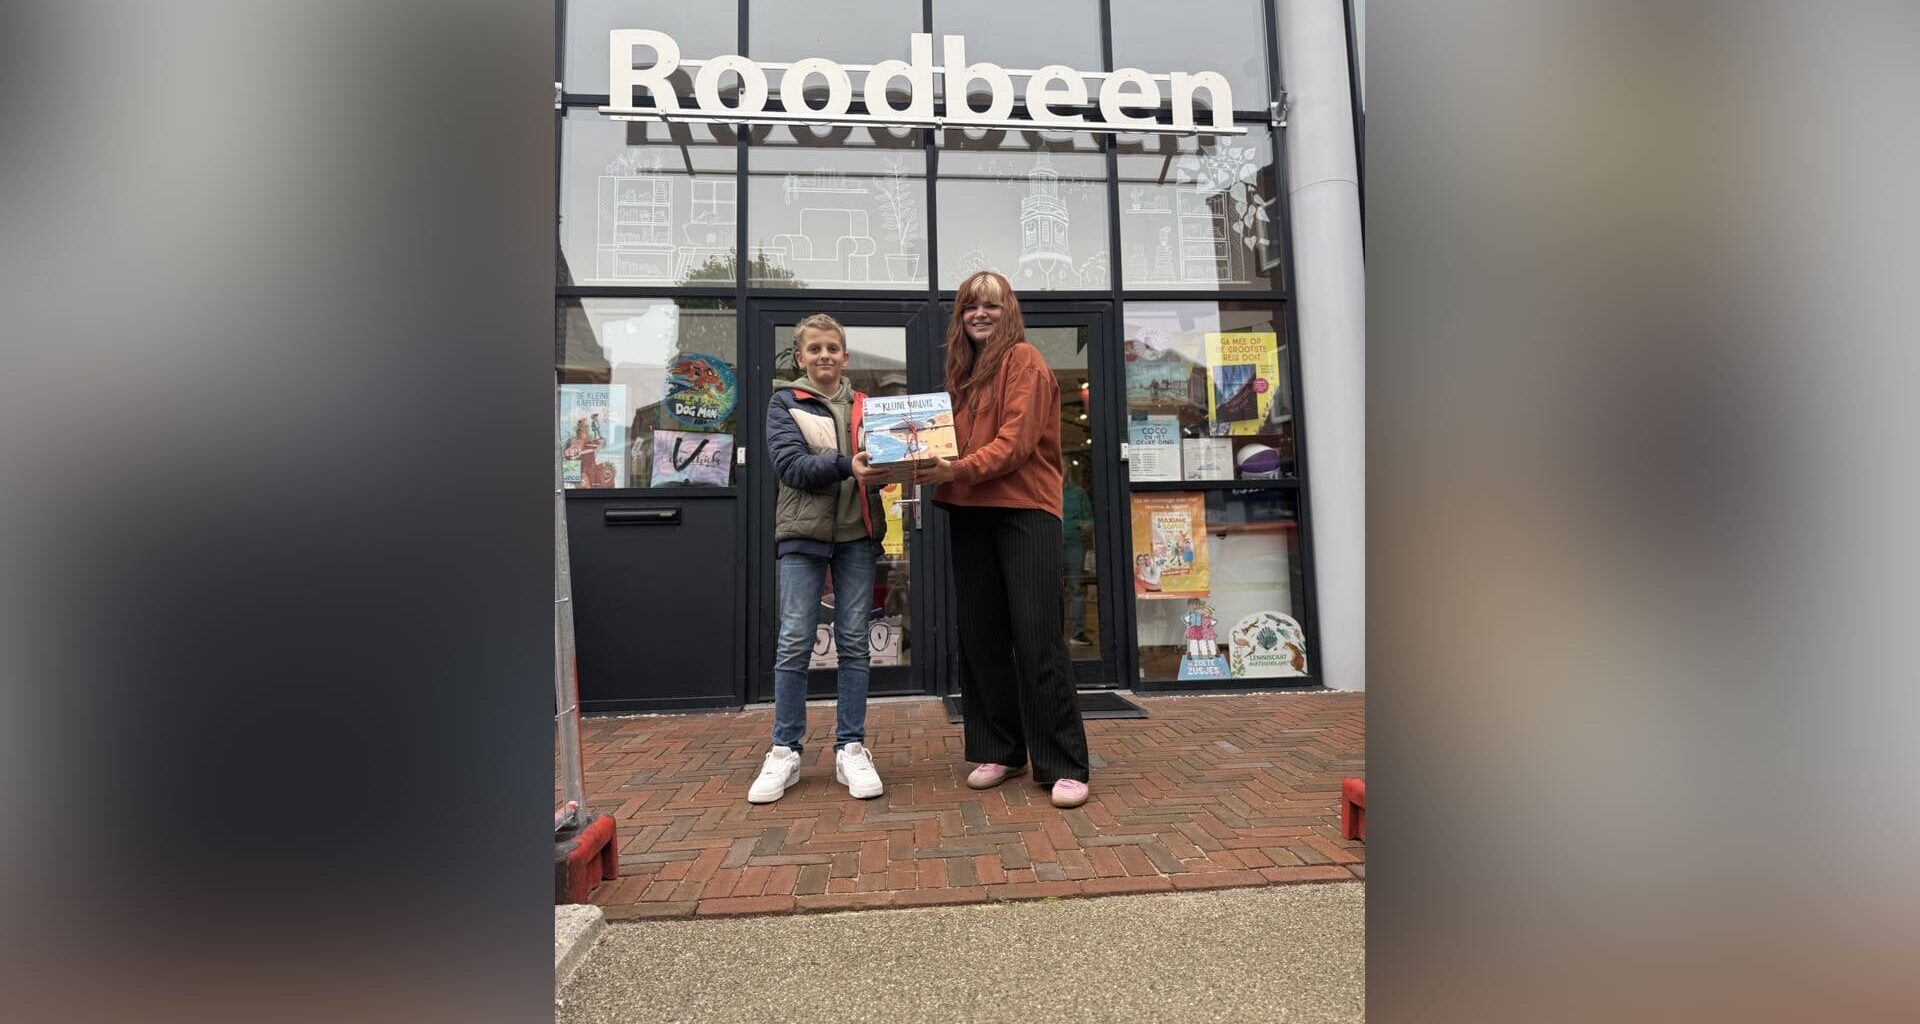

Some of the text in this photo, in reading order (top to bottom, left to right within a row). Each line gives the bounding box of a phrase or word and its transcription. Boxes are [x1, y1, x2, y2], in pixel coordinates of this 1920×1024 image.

[609, 28, 1234, 130] Roodbeen
[1227, 345, 1268, 353] GROOTSTE
[675, 403, 719, 419] DOG MAN
[882, 401, 906, 412] KLEINE
[1142, 427, 1168, 435] COCO
[1187, 666, 1220, 676] ZUSJES
